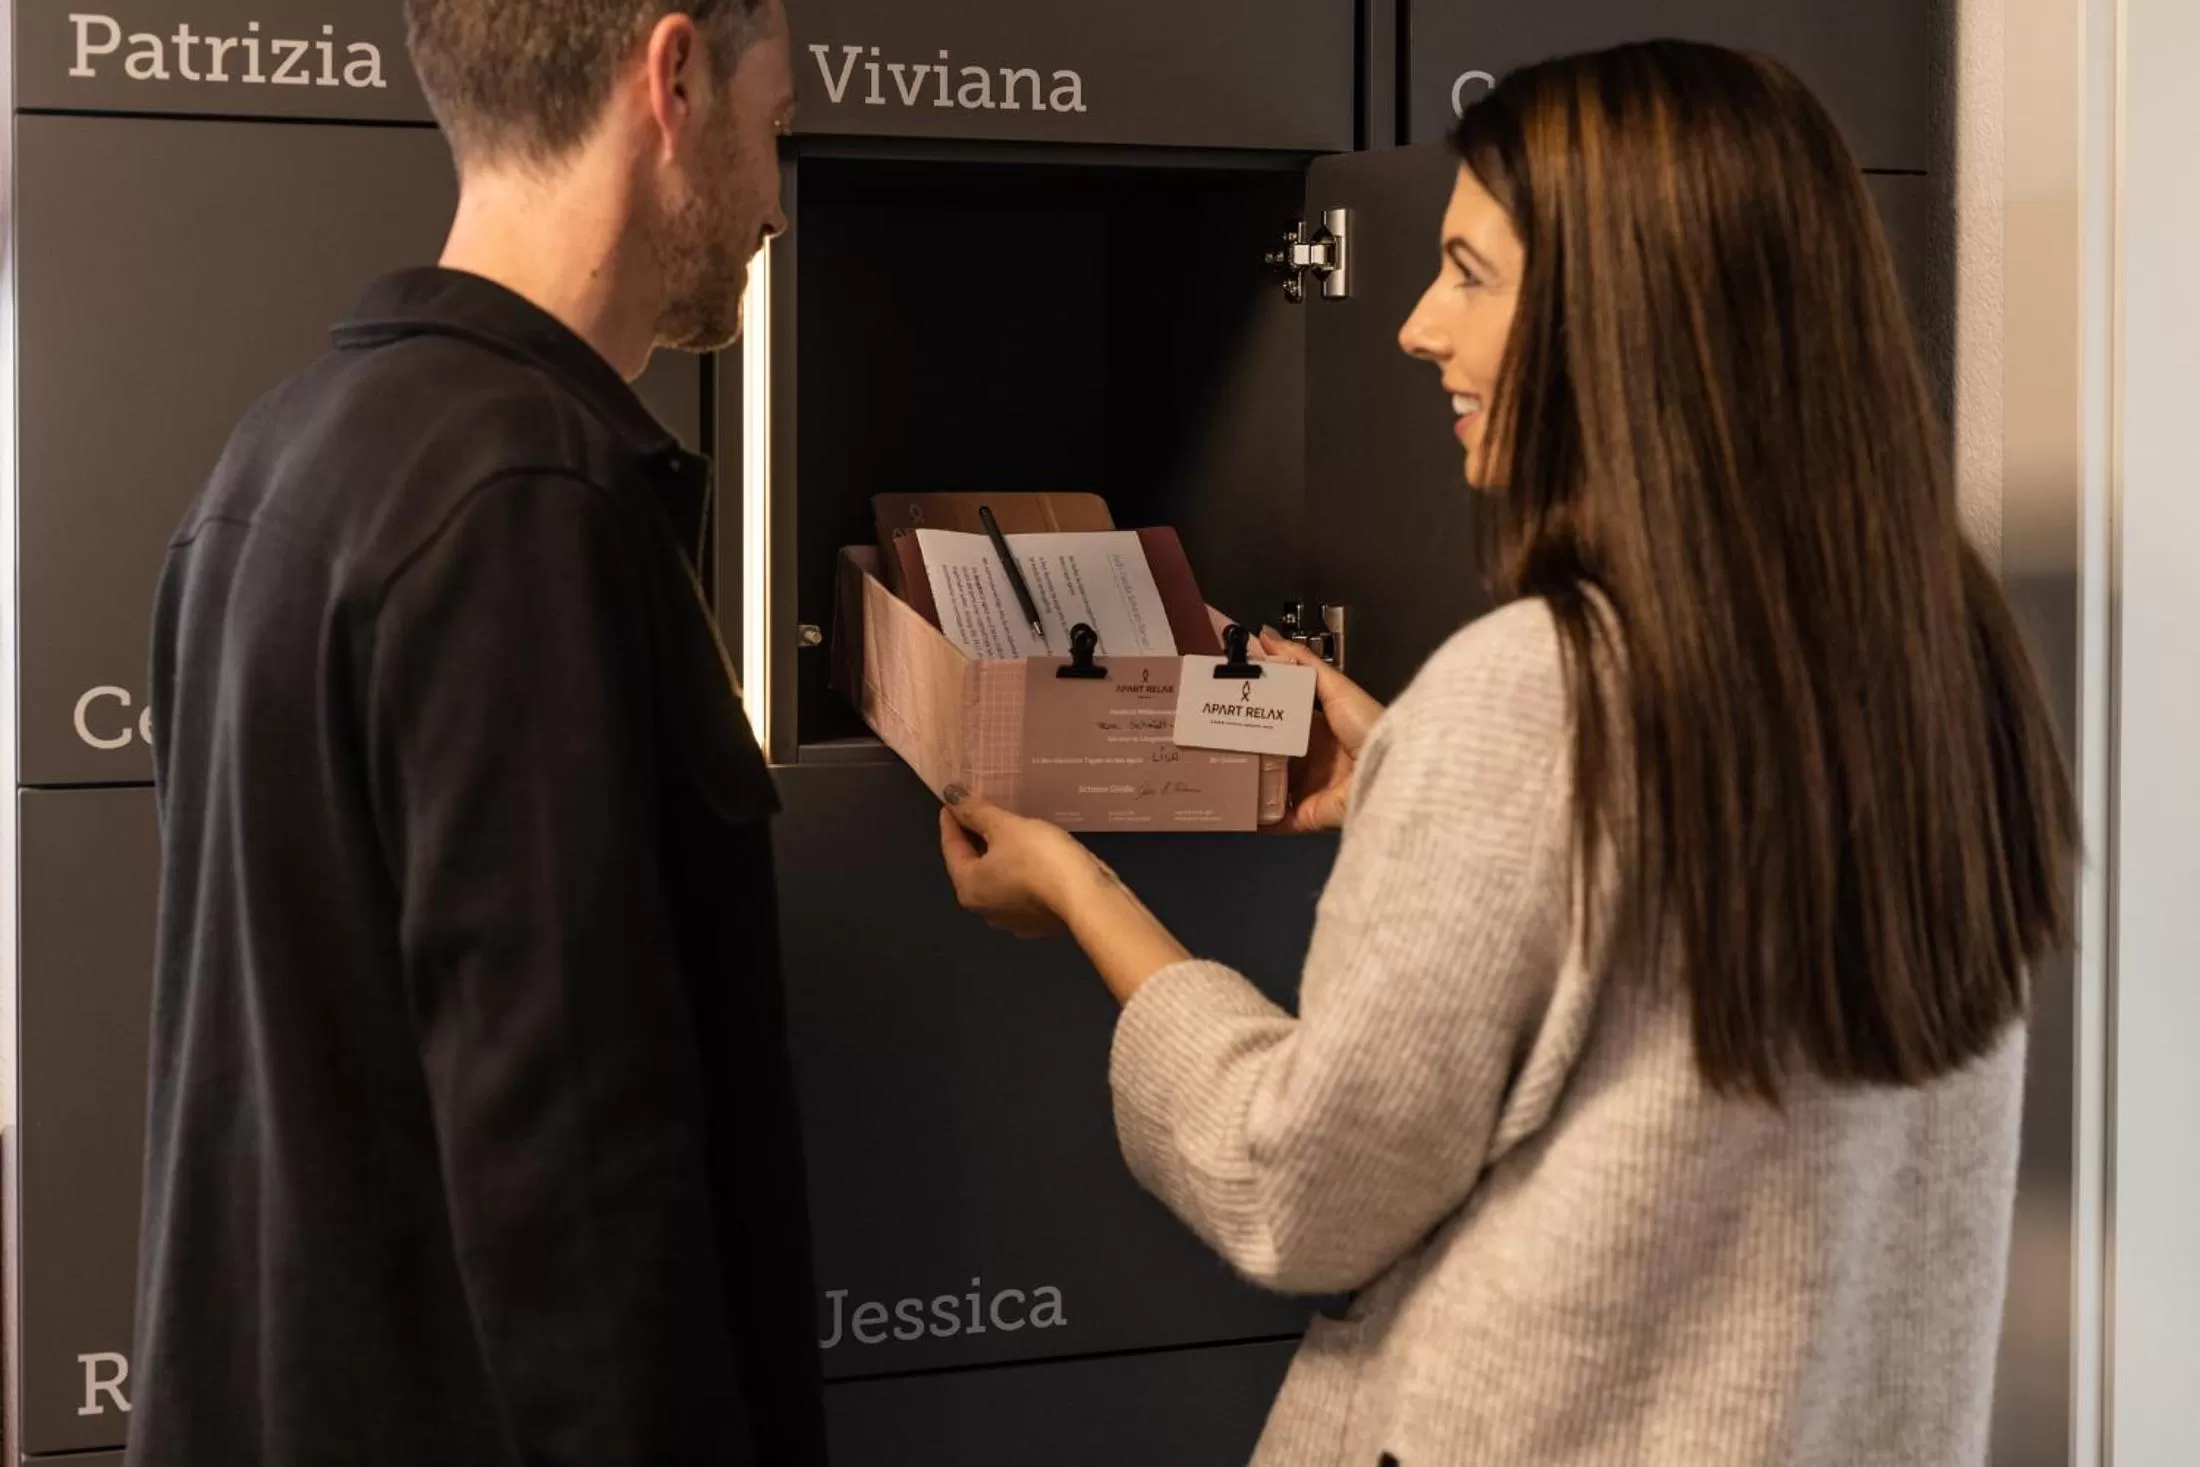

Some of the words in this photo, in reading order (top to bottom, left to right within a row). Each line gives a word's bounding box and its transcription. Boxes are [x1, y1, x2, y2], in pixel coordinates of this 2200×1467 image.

[68, 12, 387, 88] Patrizia
[808, 43, 1088, 113] Viviana
[1202, 702, 1243, 717] APART
[1245, 706, 1285, 721] RELAX
[818, 1276, 1068, 1349] Jessica
[77, 1351, 133, 1416] R
